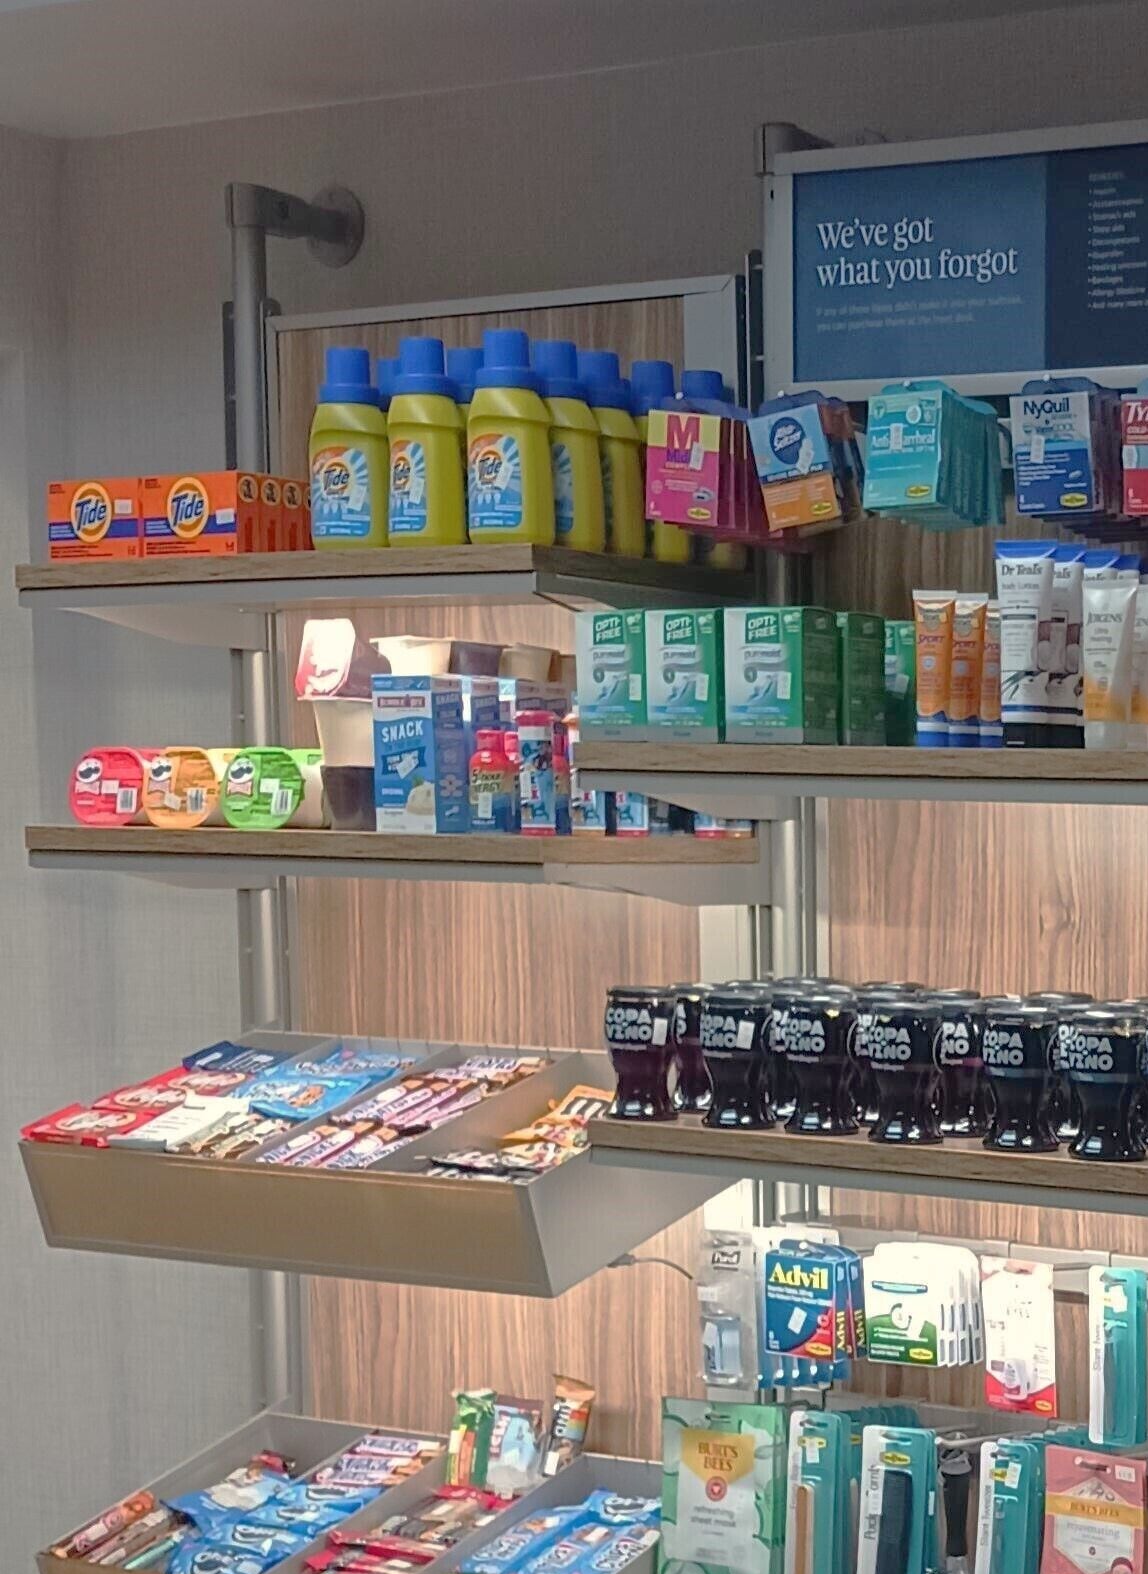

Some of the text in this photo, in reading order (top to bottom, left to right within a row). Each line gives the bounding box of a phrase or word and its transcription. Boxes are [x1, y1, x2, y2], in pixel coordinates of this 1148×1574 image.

[816, 216, 934, 251] We’ve got
[816, 247, 1018, 289] what you forgot
[1023, 397, 1069, 420] NyQuil
[478, 456, 502, 479] Tide
[324, 469, 350, 490] Tide
[75, 498, 106, 531] Tide
[171, 492, 204, 528] Tide
[1001, 563, 1015, 577] Dr
[596, 615, 621, 632] OPTI-
[665, 614, 692, 632] OPTI-
[747, 613, 777, 631] OPTI-
[595, 627, 622, 642] FREE
[665, 627, 692, 642] FREE
[747, 626, 777, 641] FREE
[918, 634, 945, 645] SPORT
[953, 640, 976, 650] SPORT
[381, 720, 424, 743] SNACK
[606, 1008, 652, 1024] COPA
[606, 1023, 653, 1042] VINO
[868, 1026, 911, 1045] COPA
[868, 1043, 912, 1062] VINO
[1066, 1053, 1114, 1071] VINO
[768, 1261, 829, 1290] Advil
[835, 1310, 846, 1351] Advil
[703, 1456, 734, 1472] BEES
